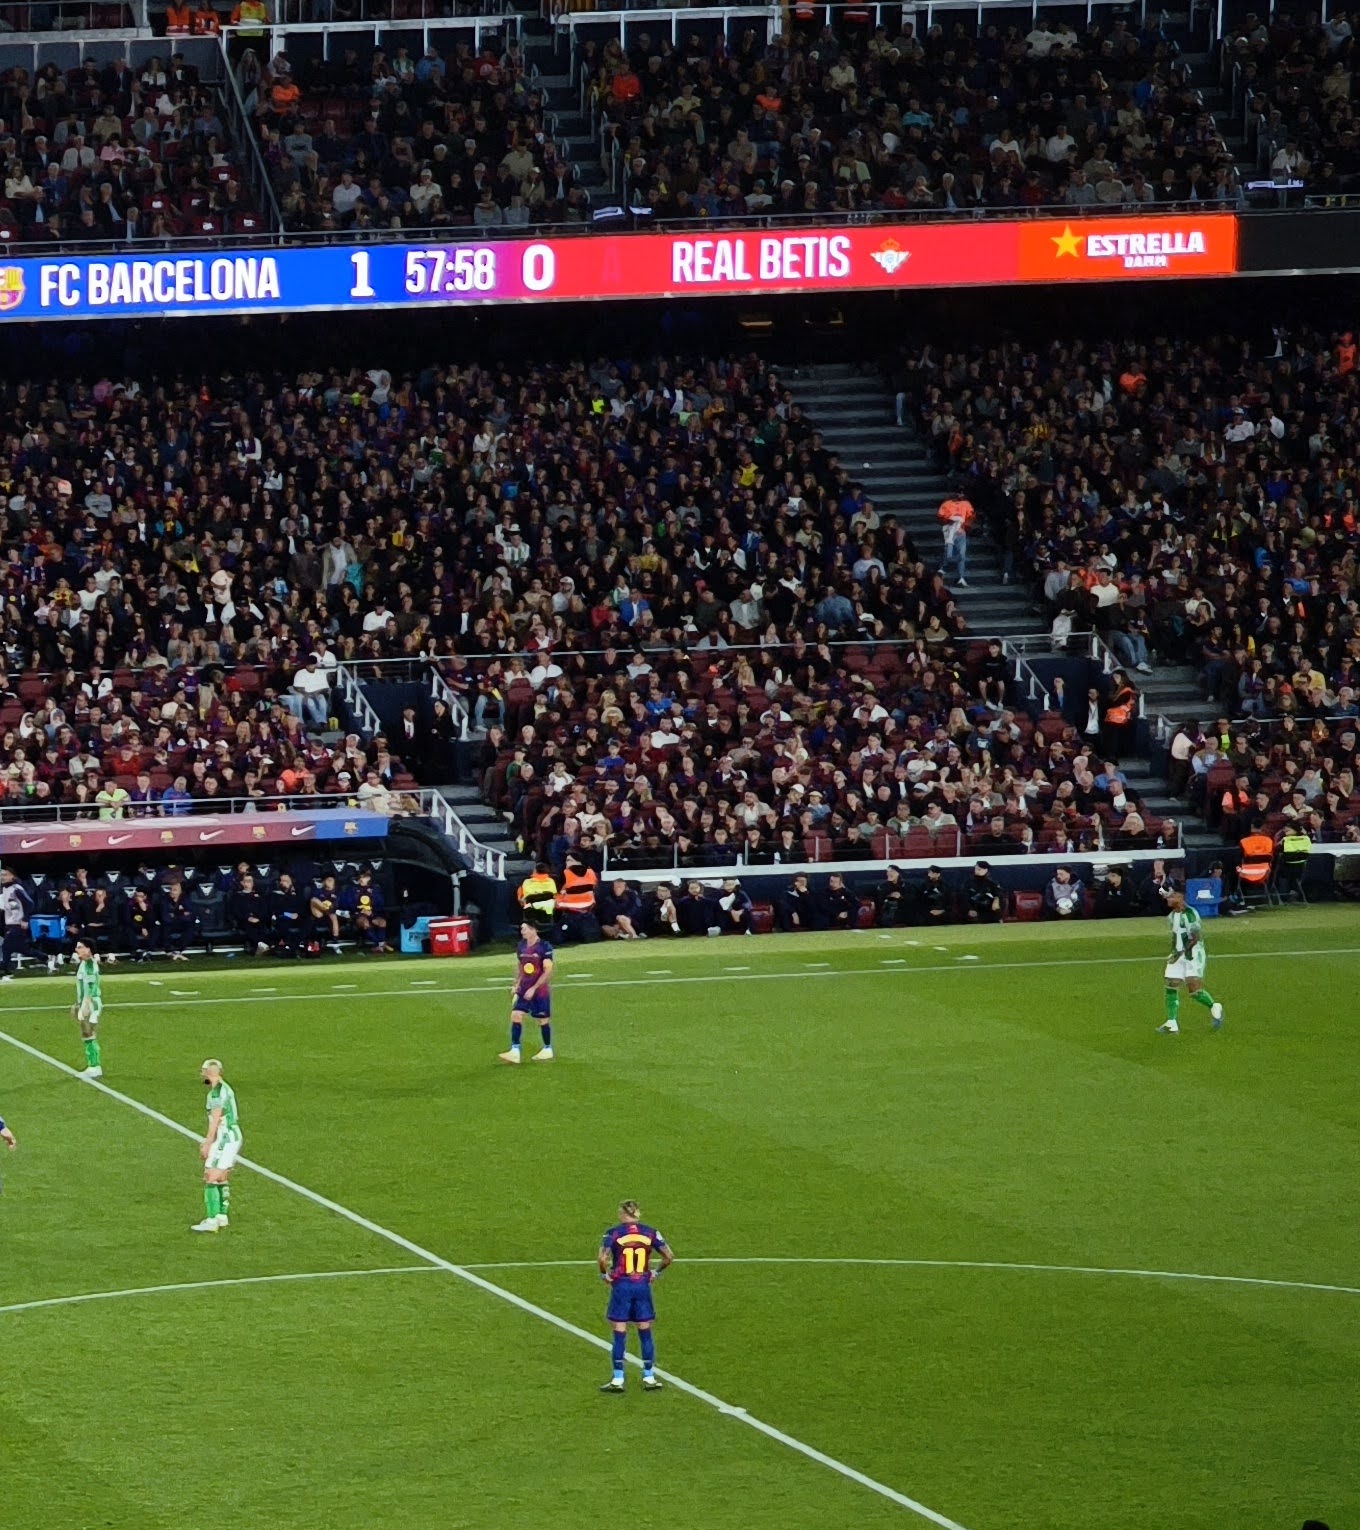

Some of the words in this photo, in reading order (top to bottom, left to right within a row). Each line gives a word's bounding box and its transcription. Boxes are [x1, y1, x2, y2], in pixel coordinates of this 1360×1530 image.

[522, 244, 555, 291] 0
[672, 239, 753, 283] REAL
[759, 236, 851, 280] BETIS
[1087, 232, 1205, 257] ESTRELLA
[41, 264, 80, 307] FC
[88, 257, 280, 305] BARCELONA
[350, 251, 374, 297] 1
[405, 249, 495, 293] 57:58
[622, 1247, 647, 1274] 11
